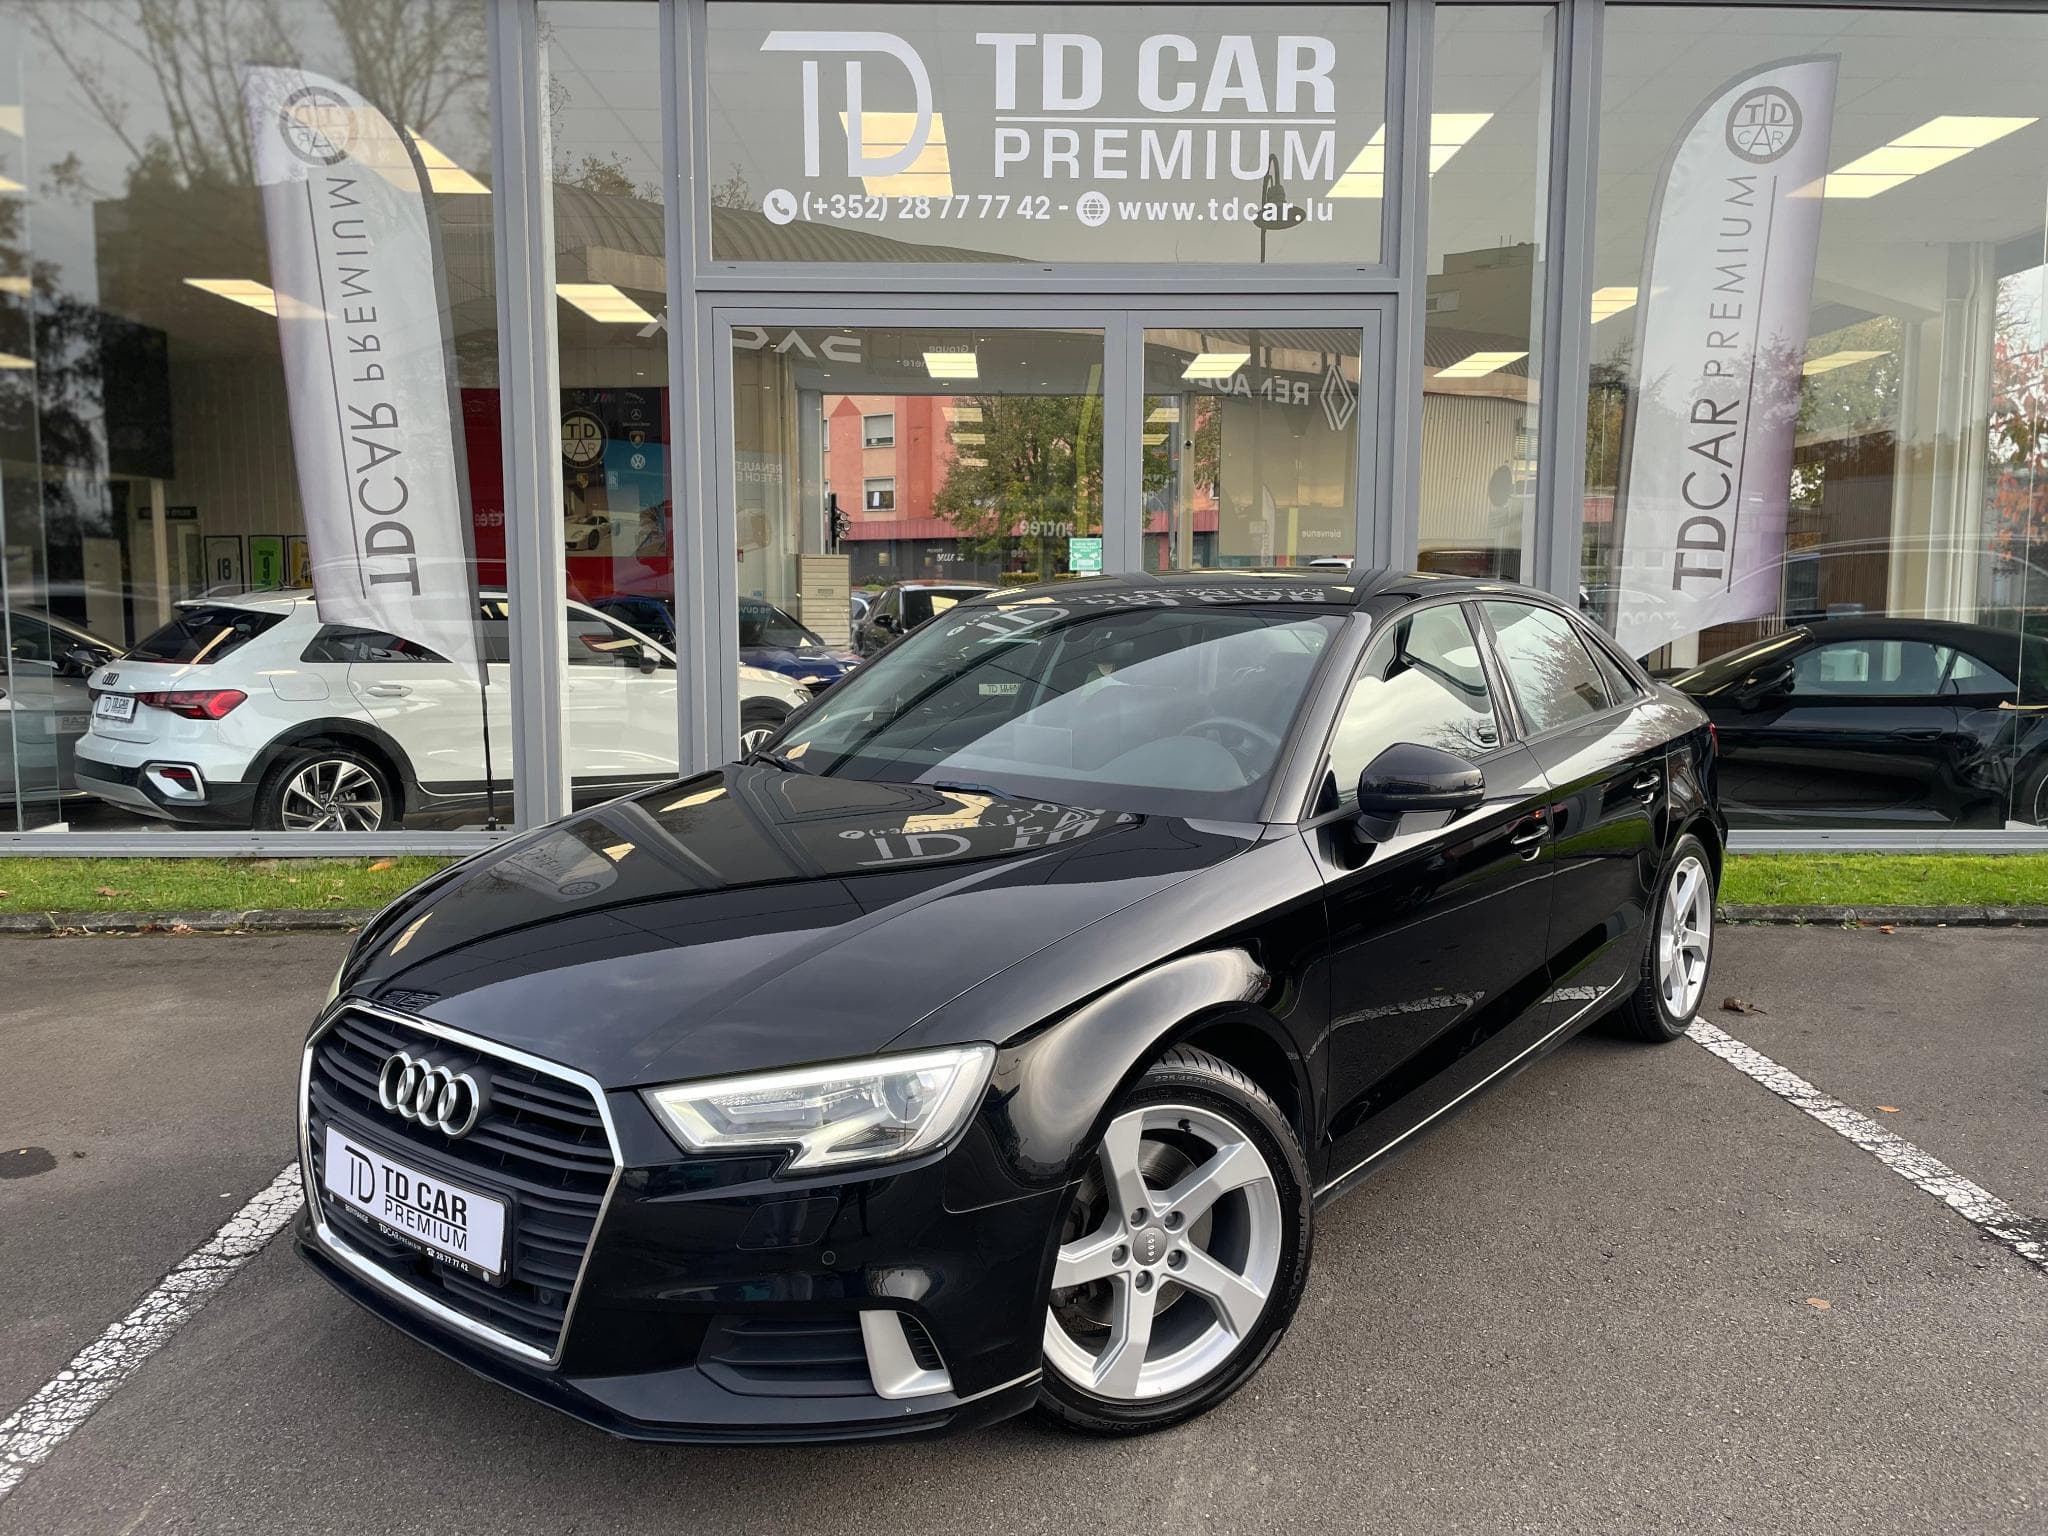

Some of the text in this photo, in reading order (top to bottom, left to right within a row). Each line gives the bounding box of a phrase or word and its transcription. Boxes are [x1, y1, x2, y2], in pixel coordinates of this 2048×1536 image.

[976, 33, 1336, 113] TD CAR
[1737, 124, 1784, 153] CAR
[1744, 103, 1787, 123] TD
[994, 129, 1335, 182] PREMIUM
[803, 194, 888, 222] (+352)
[898, 195, 931, 221] 28
[1017, 196, 1051, 221] 42
[1118, 197, 1335, 222] www.tdcar.lu
[1672, 175, 1757, 591] TDCAR PREMIUM
[565, 424, 595, 438] TD
[344, 1144, 375, 1204] TD
[382, 1164, 467, 1226] TD CAR
[385, 1198, 467, 1251] PREMIUM
